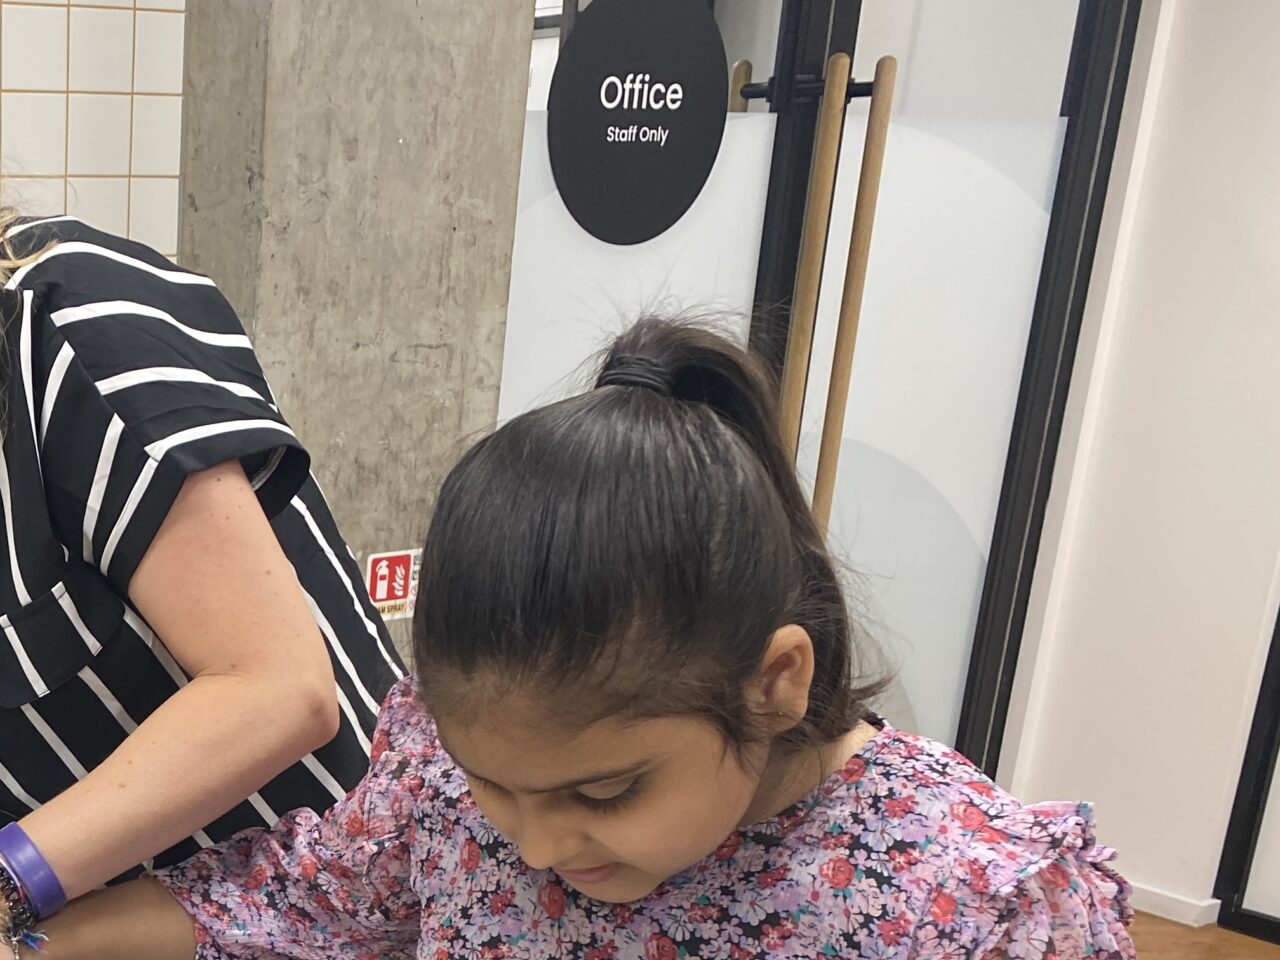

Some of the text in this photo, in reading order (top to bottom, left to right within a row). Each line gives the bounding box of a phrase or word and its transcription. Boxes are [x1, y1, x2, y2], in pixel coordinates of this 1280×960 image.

[600, 73, 683, 110] Office
[607, 125, 669, 146] Staff Only
[387, 604, 405, 613] SPRAY
